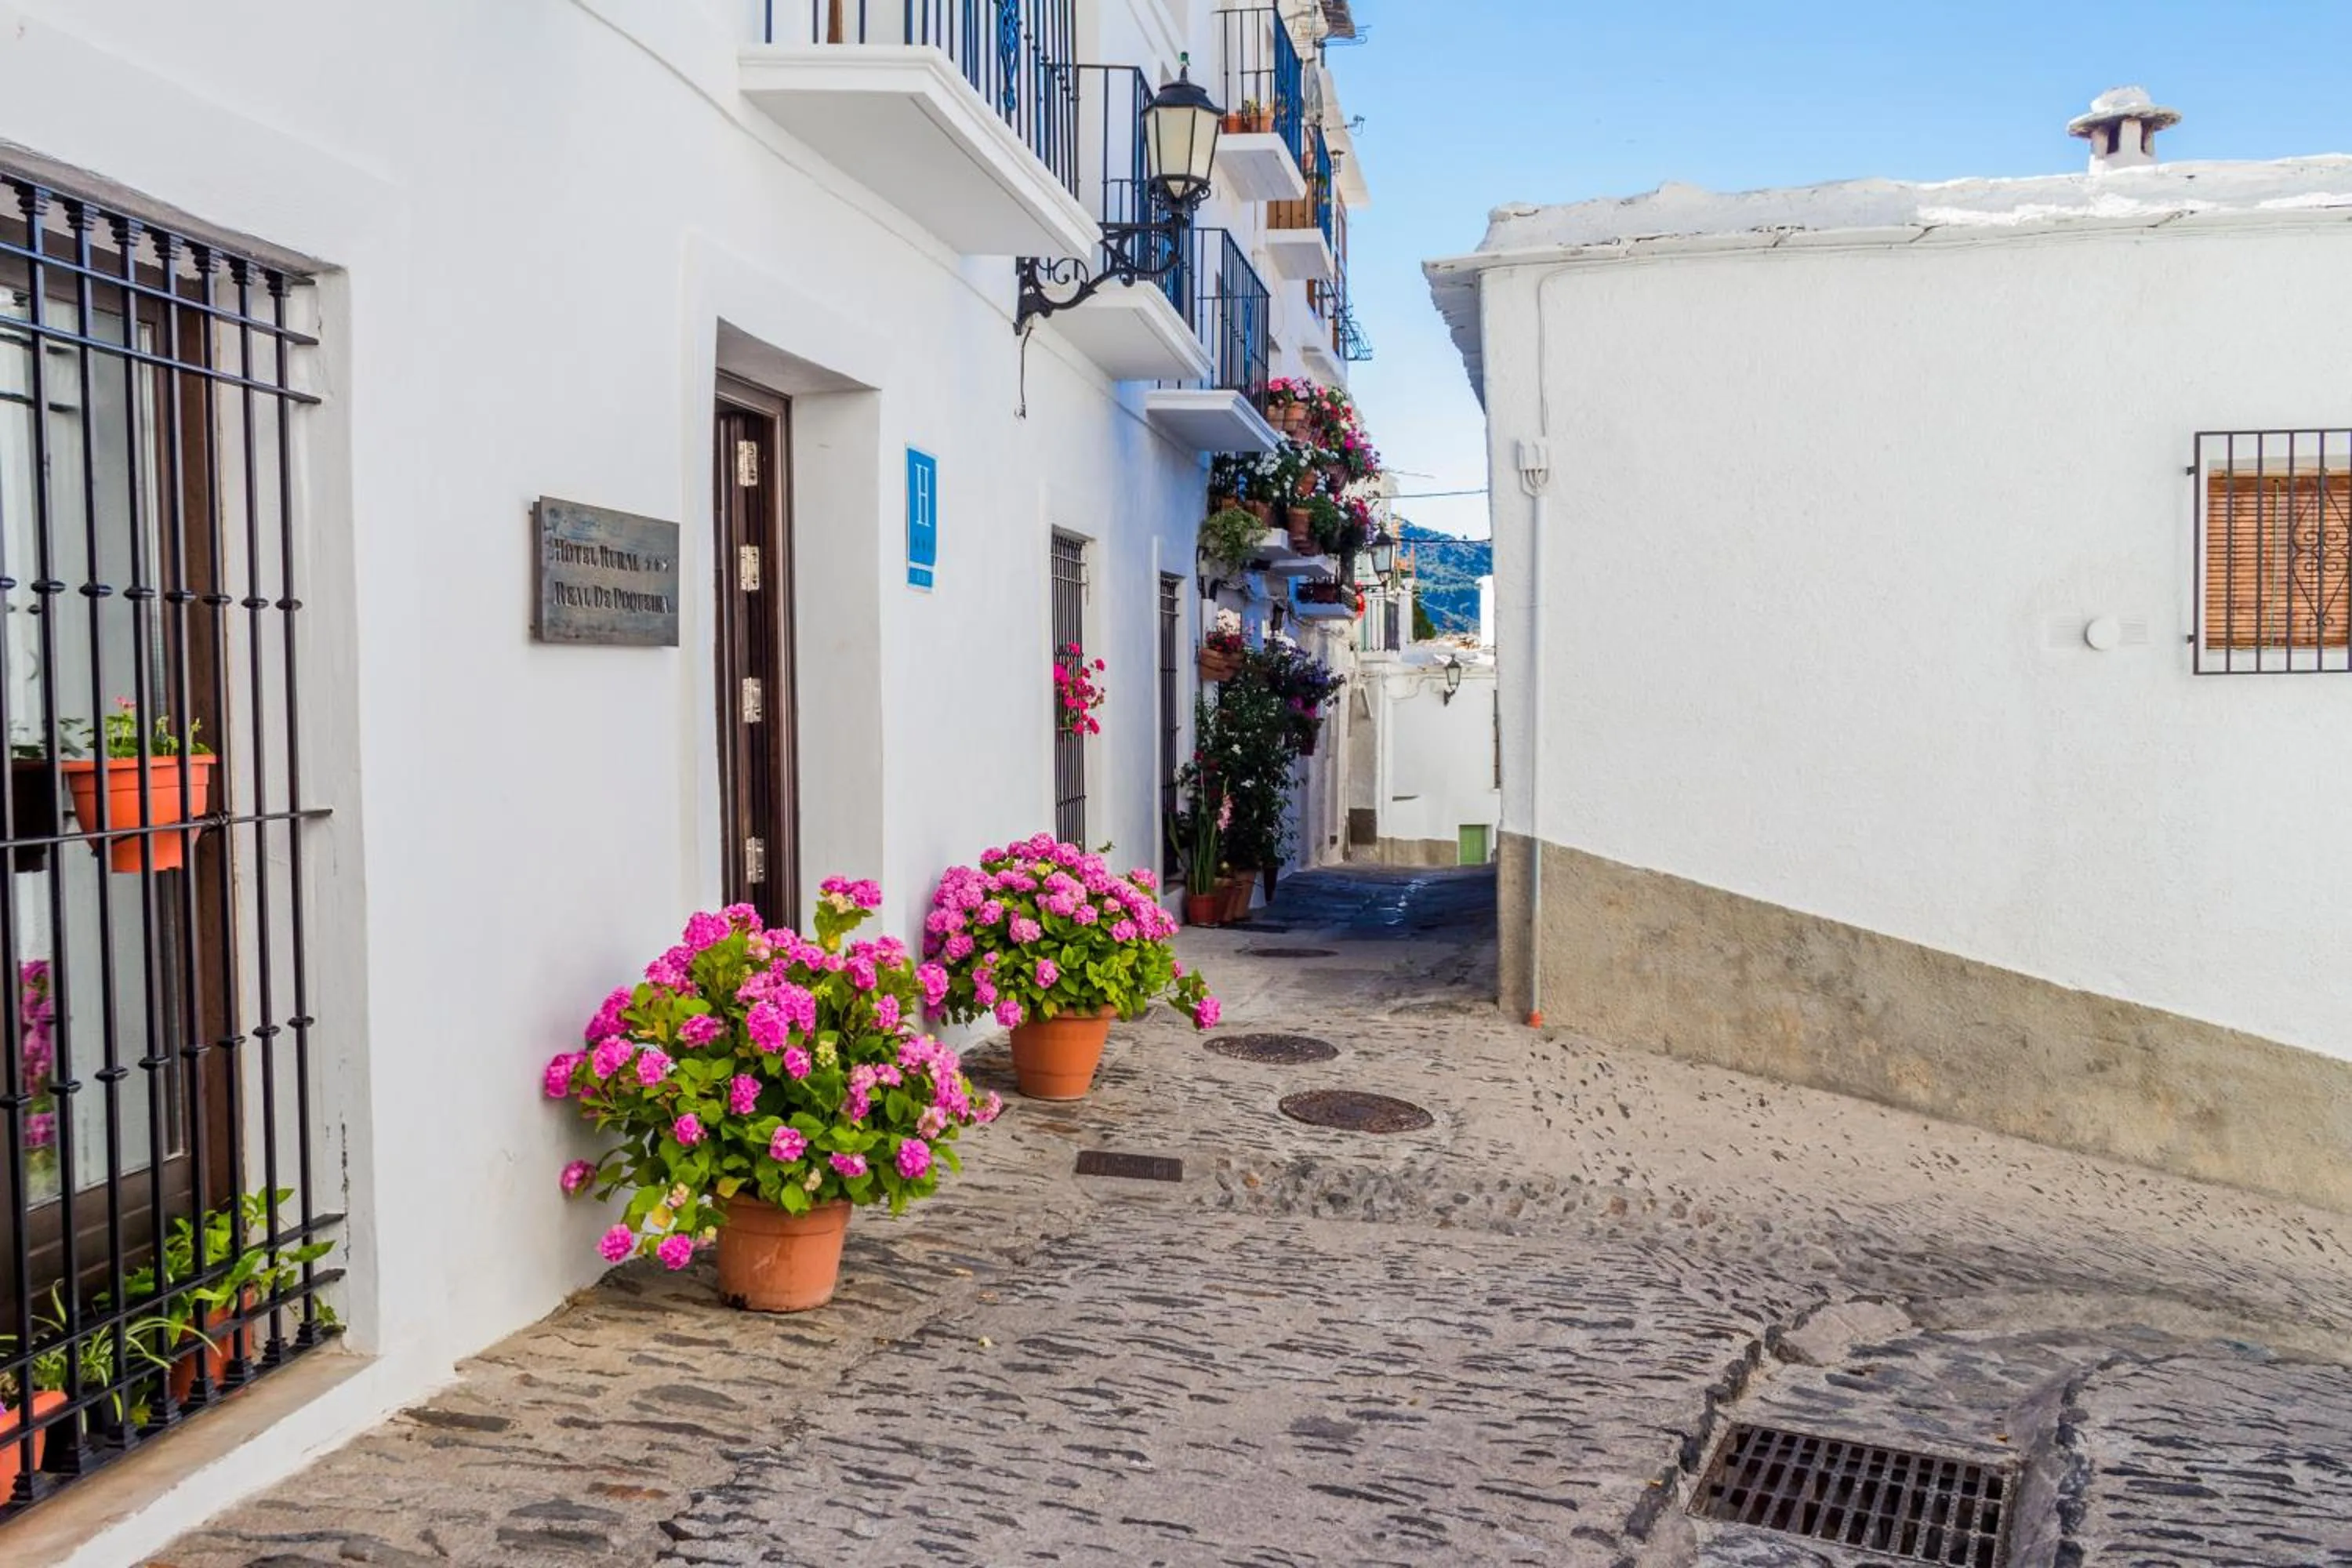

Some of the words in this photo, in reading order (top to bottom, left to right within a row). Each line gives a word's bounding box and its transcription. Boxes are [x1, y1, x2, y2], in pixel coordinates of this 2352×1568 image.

[916, 463, 931, 527] H
[554, 539, 597, 566] HOTEL
[599, 545, 640, 572] RURAL
[554, 582, 590, 607] REAL
